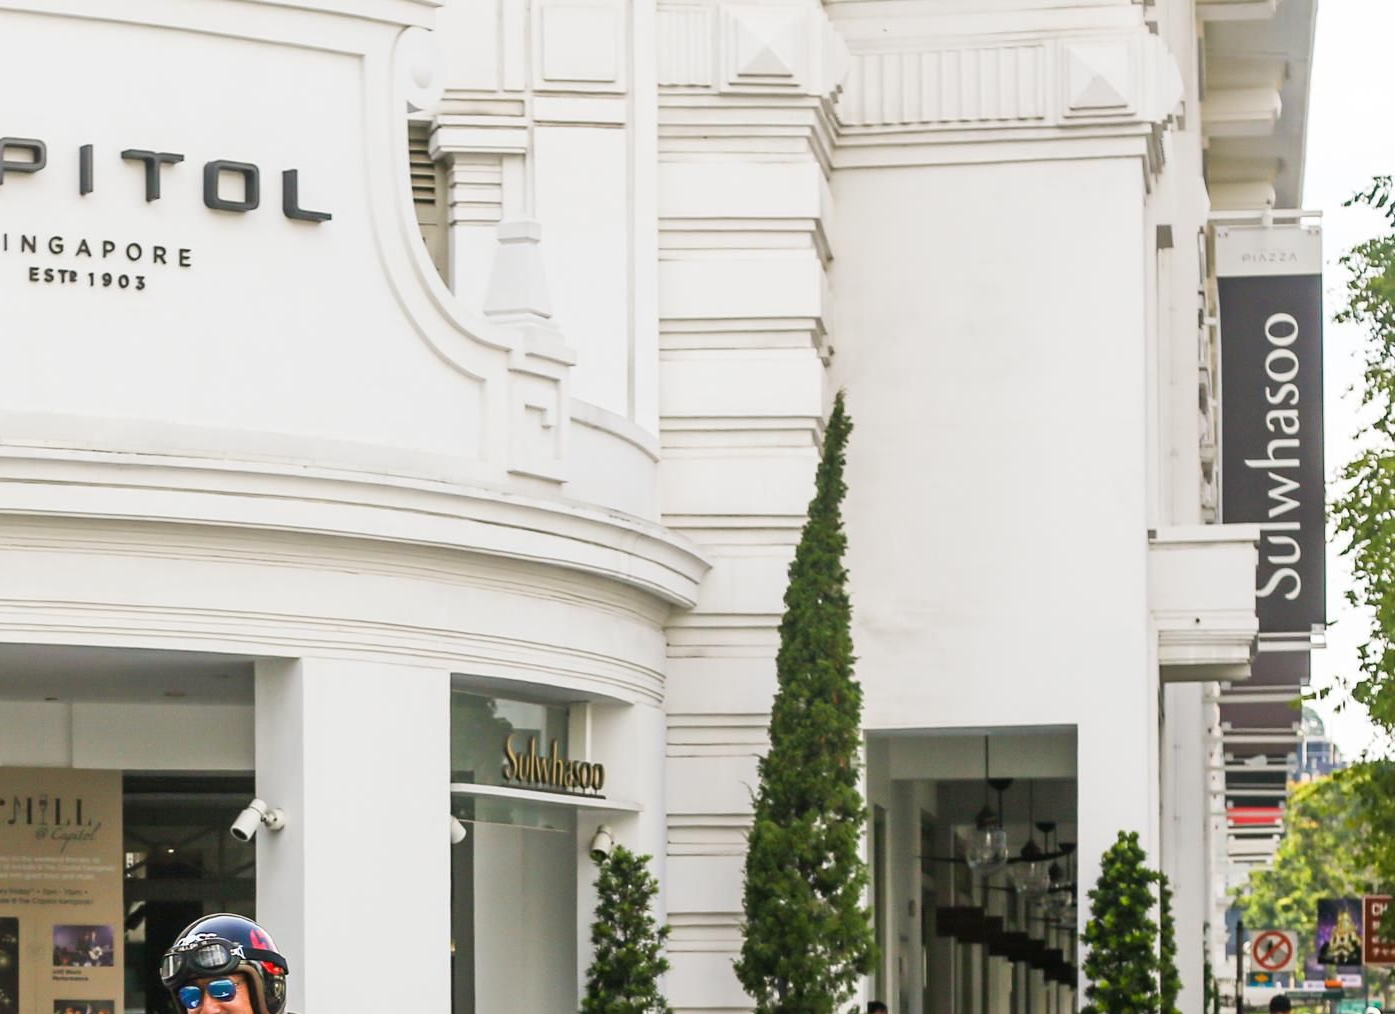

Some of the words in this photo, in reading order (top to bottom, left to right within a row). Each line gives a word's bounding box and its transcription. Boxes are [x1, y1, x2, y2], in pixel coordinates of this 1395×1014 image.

[88, 271, 147, 291] 1903
[1244, 312, 1301, 600] Sulwhasoo
[502, 733, 605, 791] Sulwhasoo
